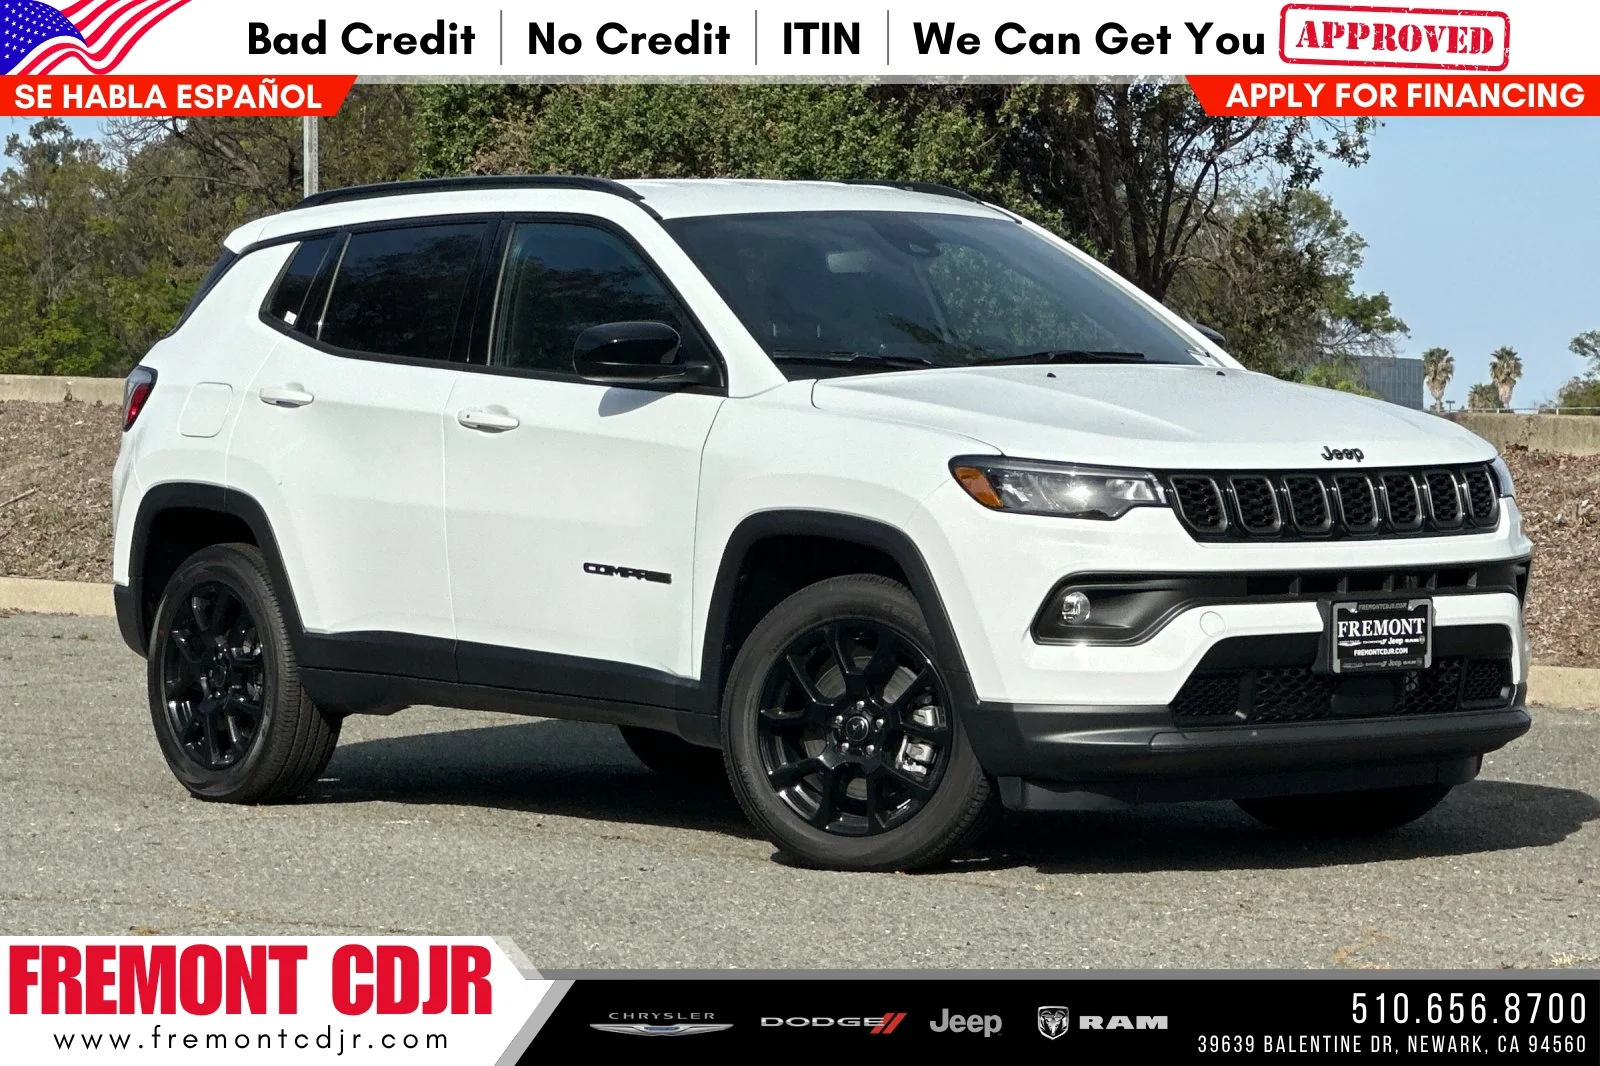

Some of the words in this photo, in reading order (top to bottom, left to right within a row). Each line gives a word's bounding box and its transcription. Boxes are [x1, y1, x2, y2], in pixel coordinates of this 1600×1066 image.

[1321, 446, 1364, 463] Jeep
[1337, 617, 1426, 638] FREMONT
[1388, 637, 1404, 645] Jeep
[1353, 647, 1409, 656] FREMONTCDJR.COM
